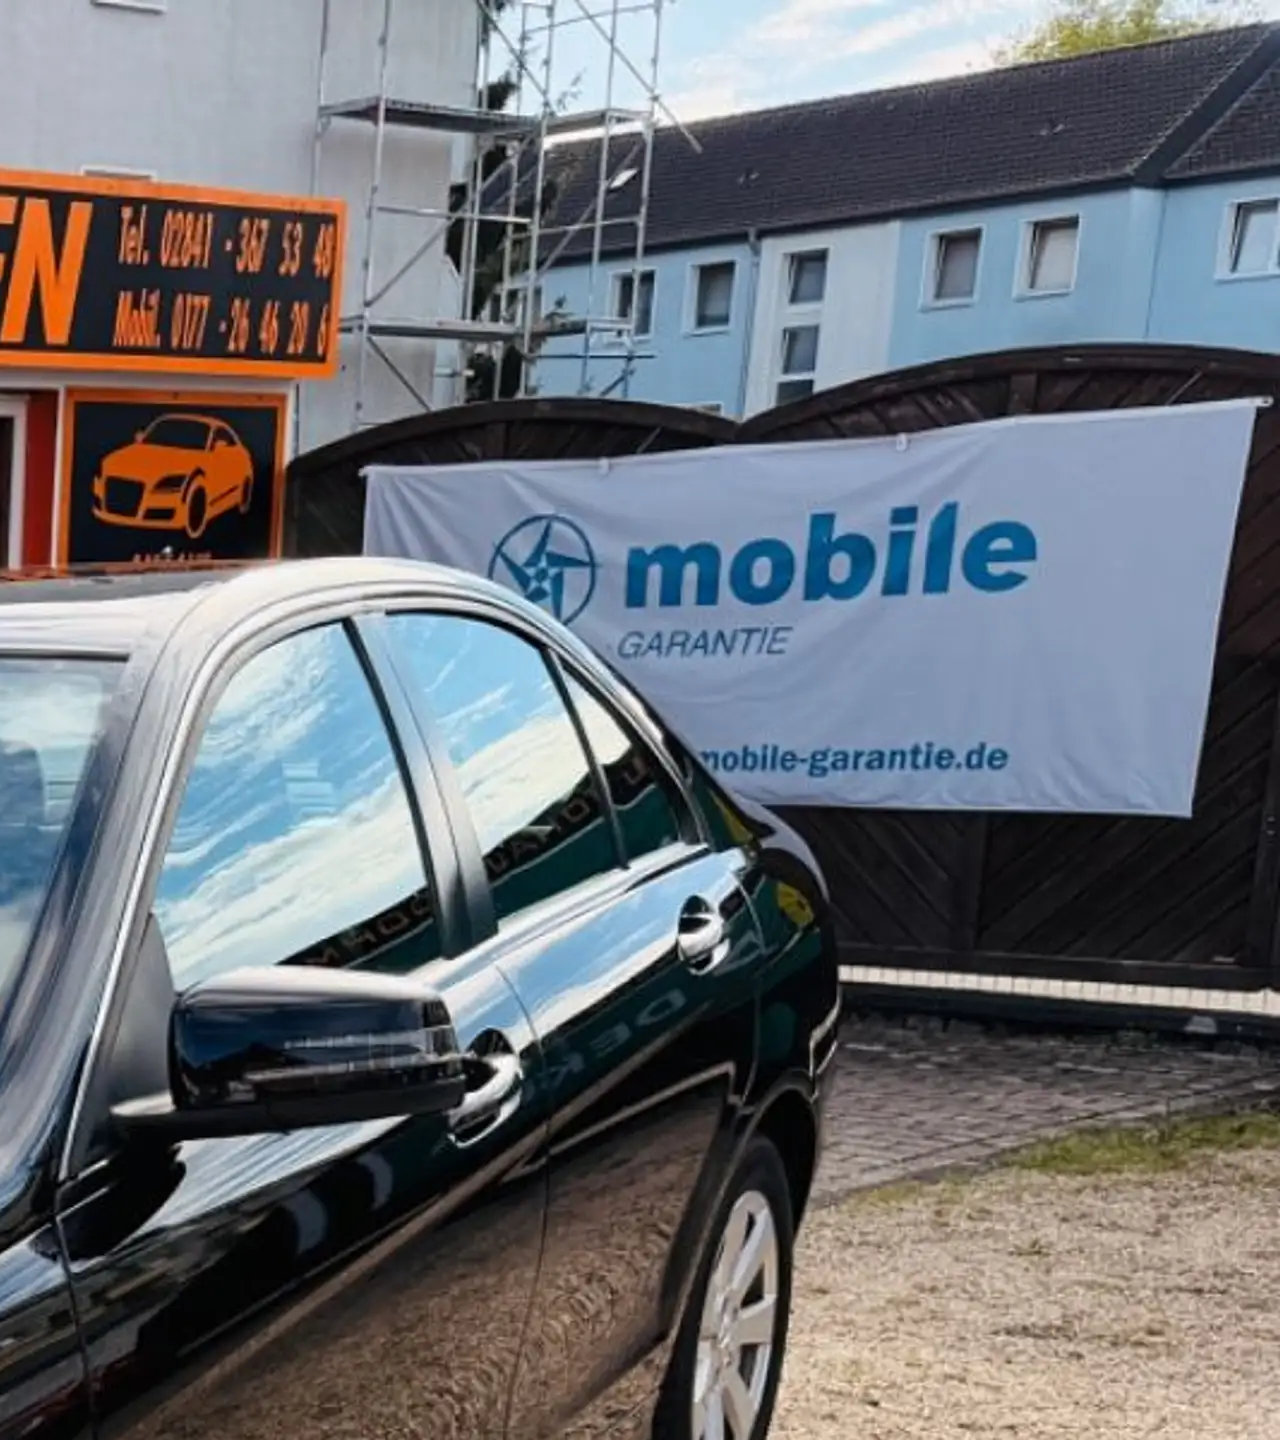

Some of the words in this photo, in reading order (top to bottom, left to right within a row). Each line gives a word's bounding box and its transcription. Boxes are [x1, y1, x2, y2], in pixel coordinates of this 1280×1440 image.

[118, 204, 148, 266] Tel.
[160, 208, 213, 269] 02841
[236, 217, 270, 273] 367
[279, 221, 303, 277] 53
[112, 288, 160, 347] Mobil.
[171, 292, 211, 350] 0177
[624, 502, 1038, 609] mobile
[617, 626, 793, 660] GARANTIE
